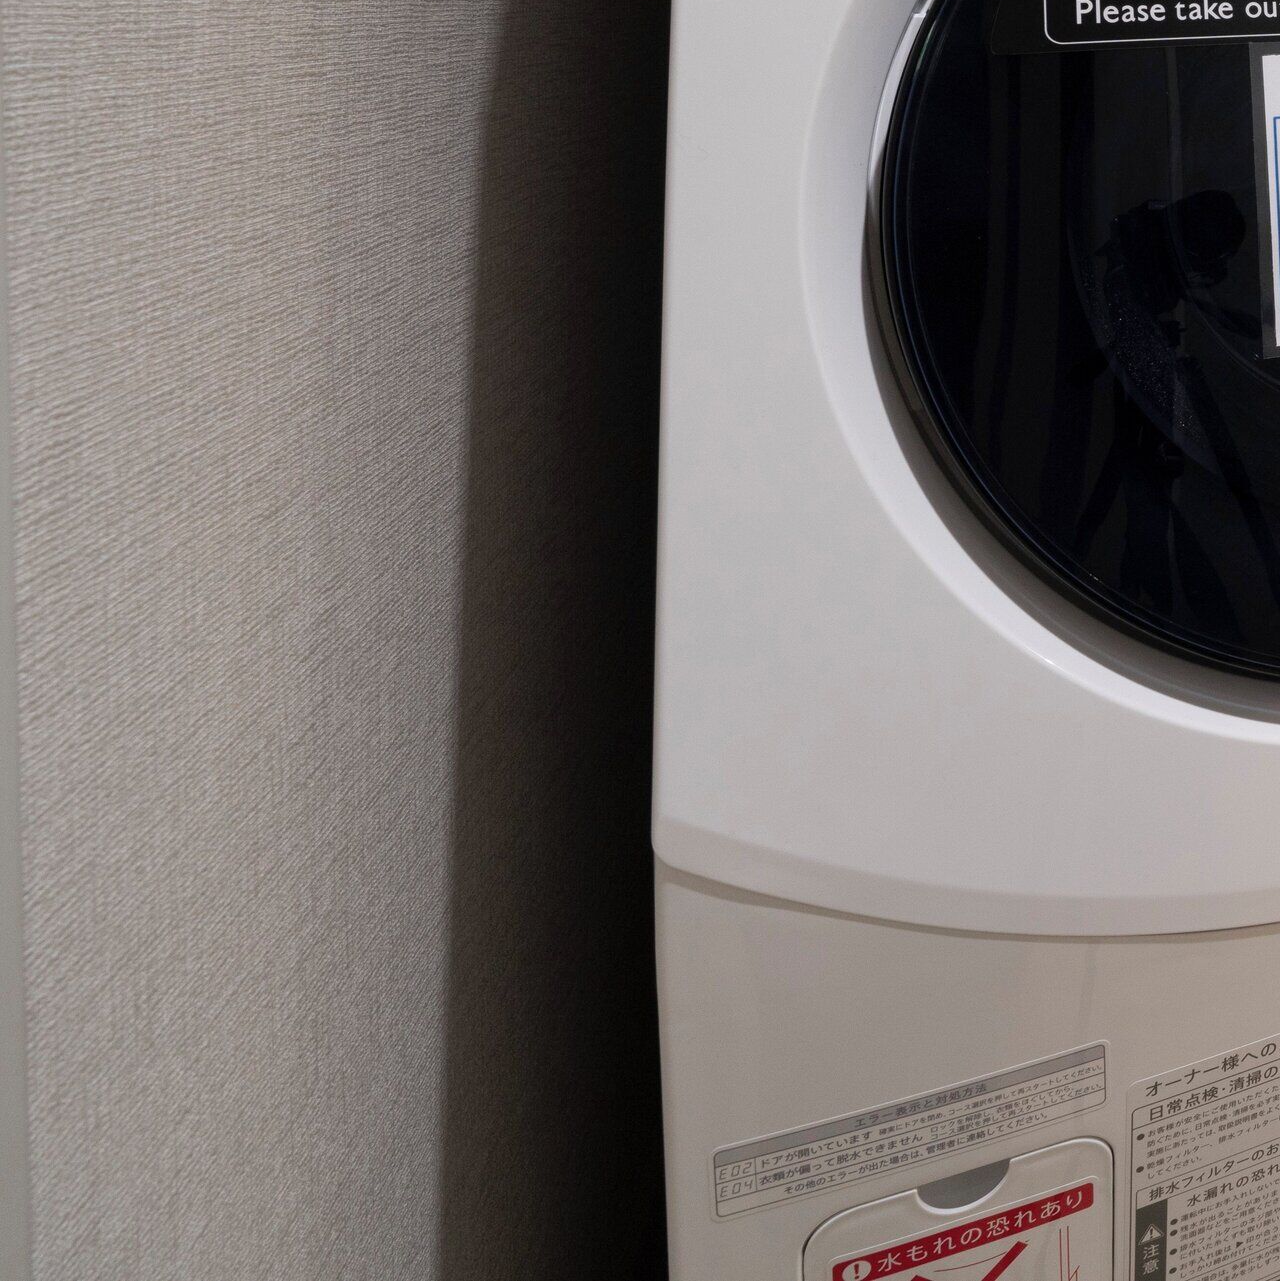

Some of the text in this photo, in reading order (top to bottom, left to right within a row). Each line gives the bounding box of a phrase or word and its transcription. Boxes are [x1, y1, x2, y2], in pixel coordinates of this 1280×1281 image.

[878, 1189, 1083, 1272] 水もれの恐れあり
